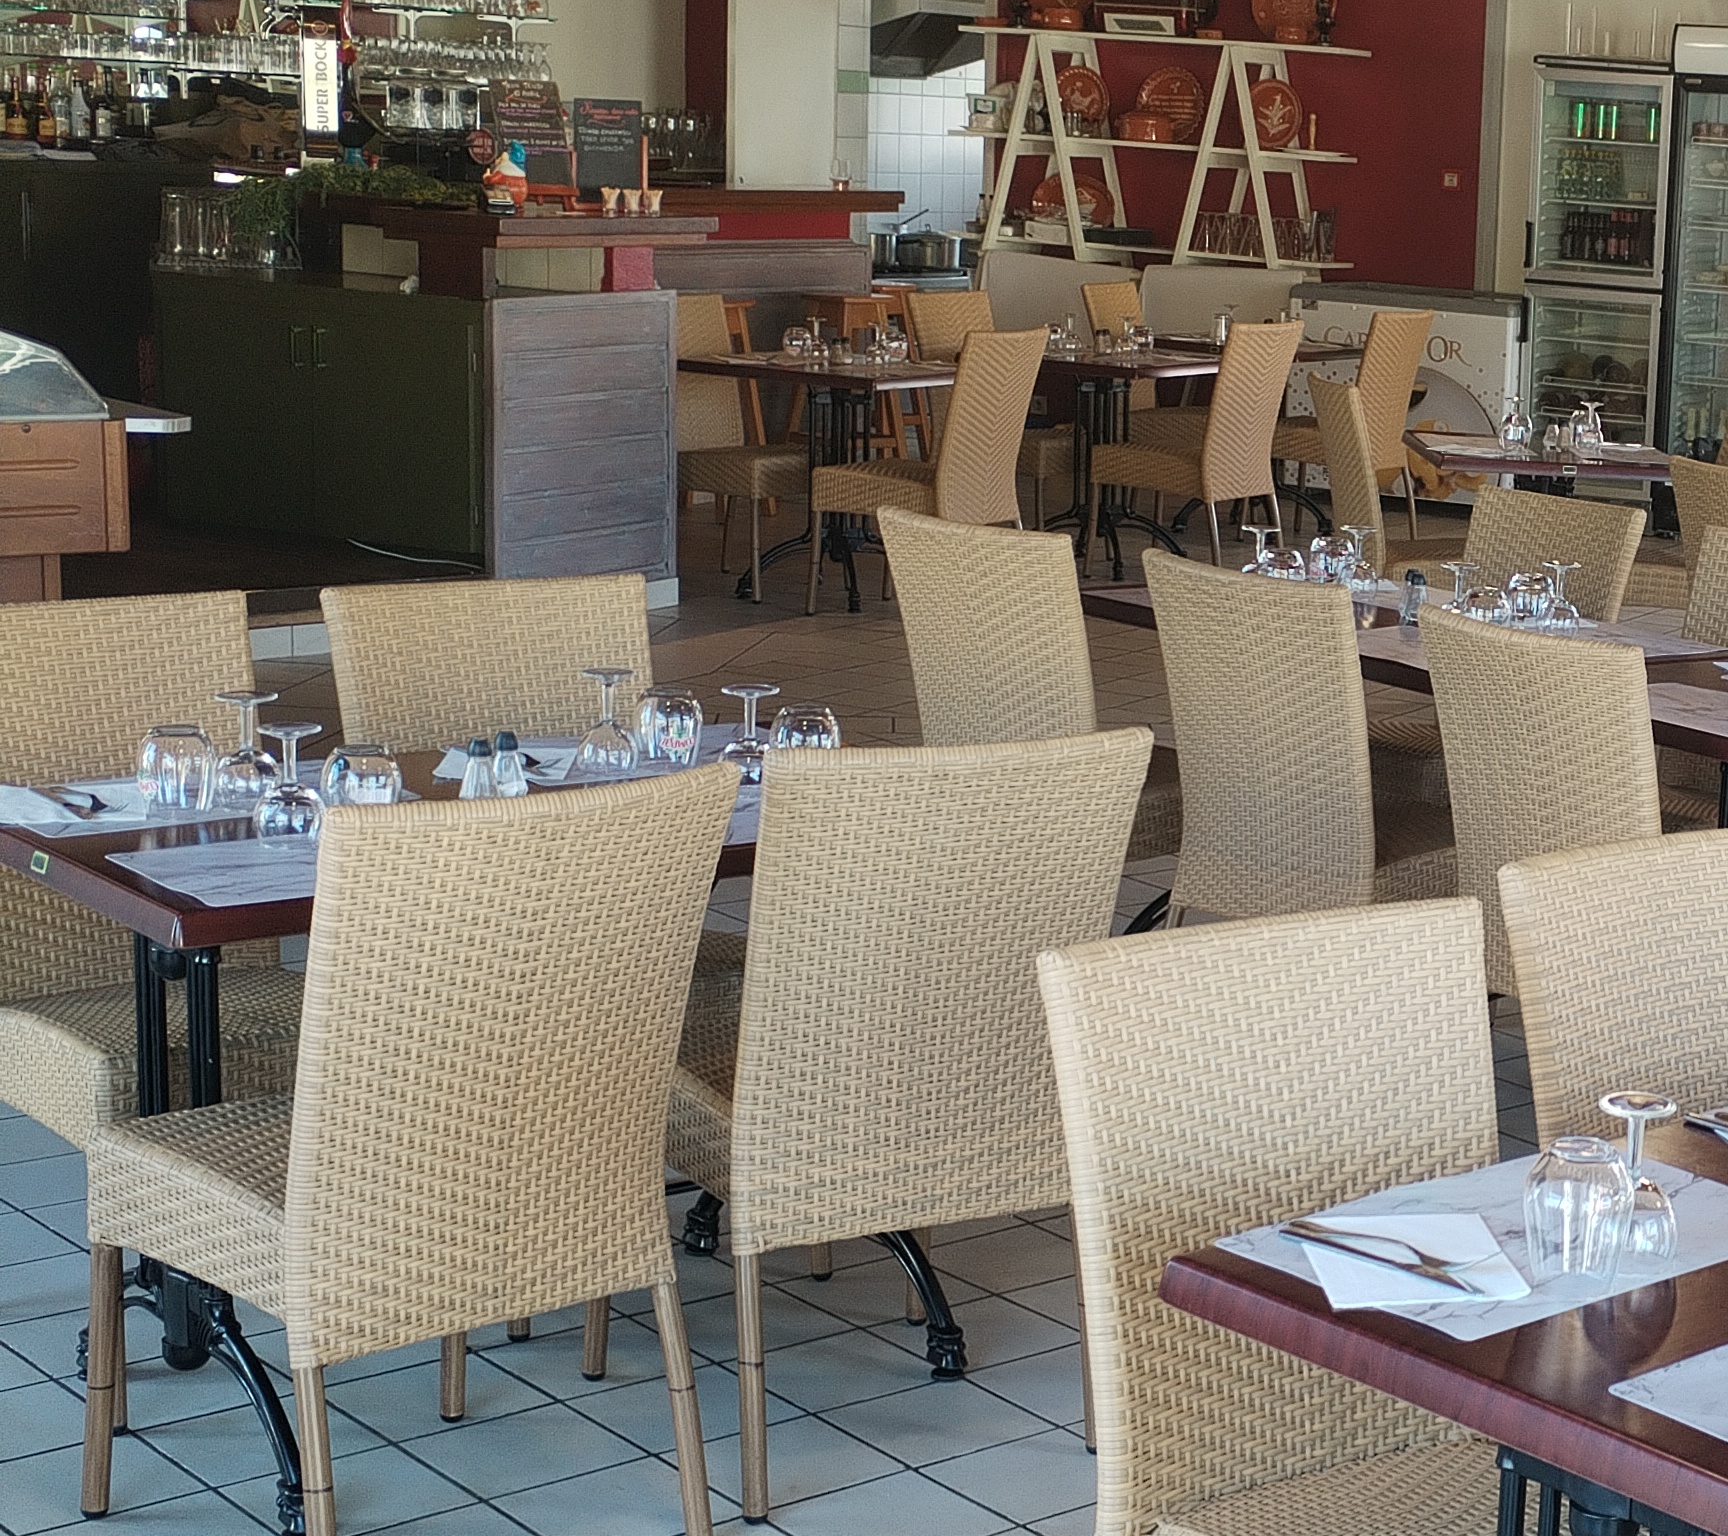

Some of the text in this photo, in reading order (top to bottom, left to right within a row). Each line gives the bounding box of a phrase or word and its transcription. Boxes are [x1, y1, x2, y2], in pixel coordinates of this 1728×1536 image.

[314, 40, 330, 133] SUPER BOCK
[1323, 325, 1472, 367] CAR OR
